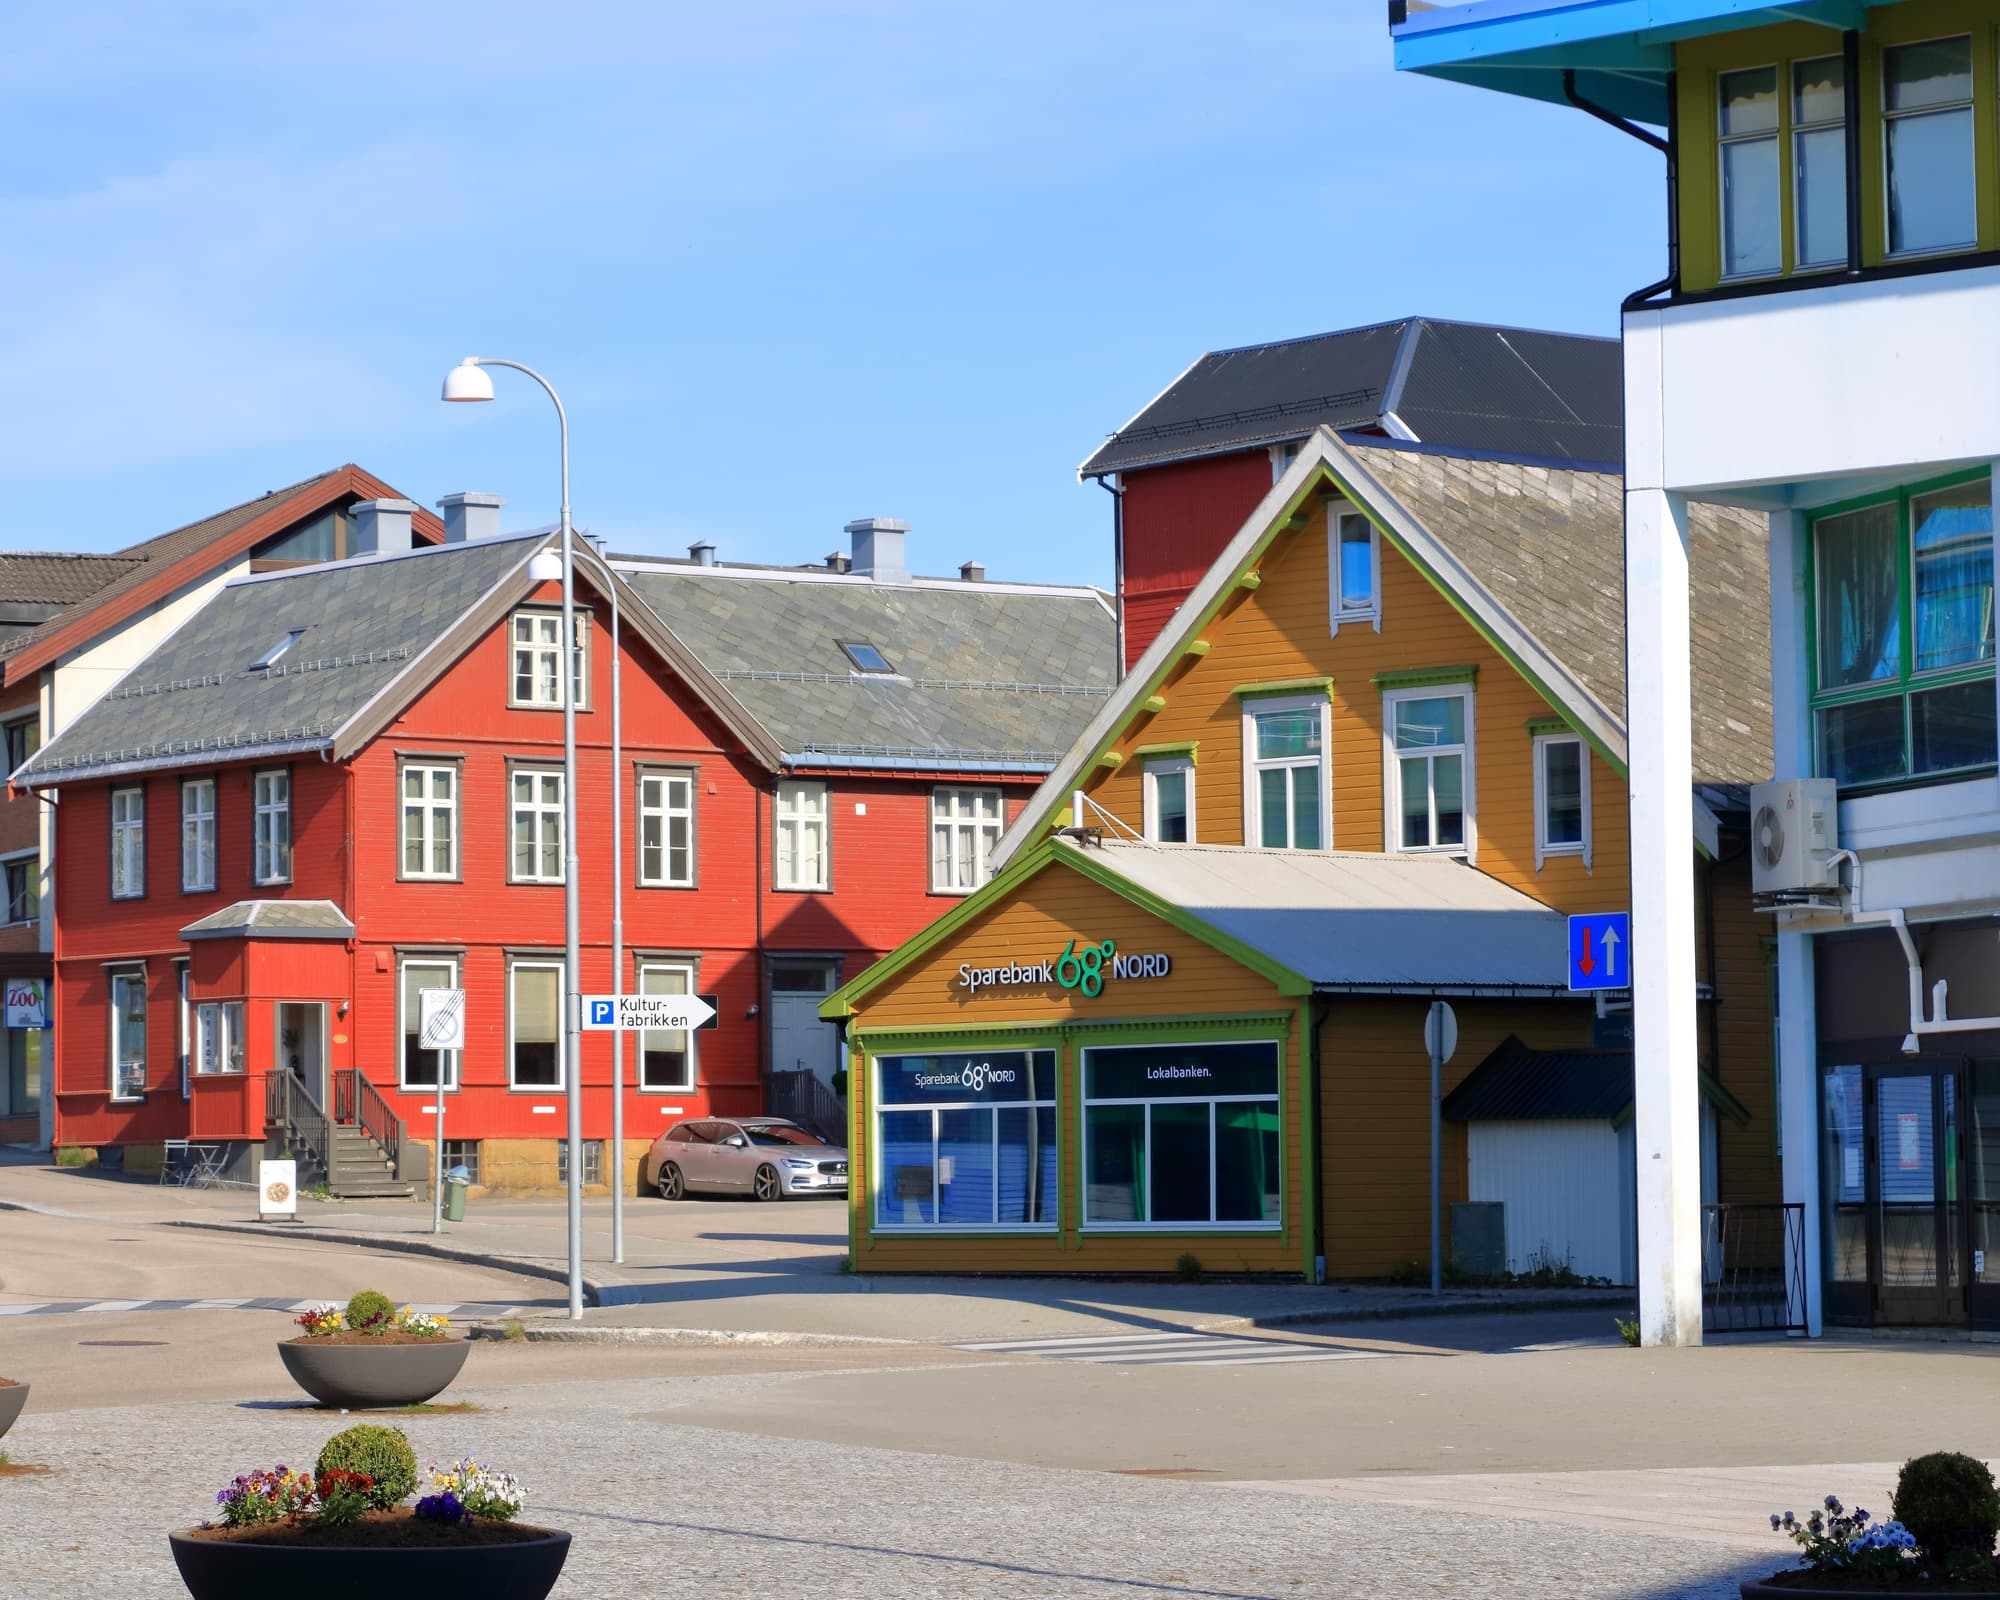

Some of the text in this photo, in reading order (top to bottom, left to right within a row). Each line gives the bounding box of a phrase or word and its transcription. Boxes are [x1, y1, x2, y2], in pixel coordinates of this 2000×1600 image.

[959, 959, 1053, 993] Sparebank
[1113, 954, 1169, 979] NORD
[620, 998, 668, 1011] Kultur-
[596, 1003, 609, 1022] P
[621, 1013, 688, 1026] fabrikken
[914, 1072, 960, 1088] Sparebank
[988, 1071, 1015, 1083] NORD
[1147, 1066, 1212, 1080] Lokalbanken.
